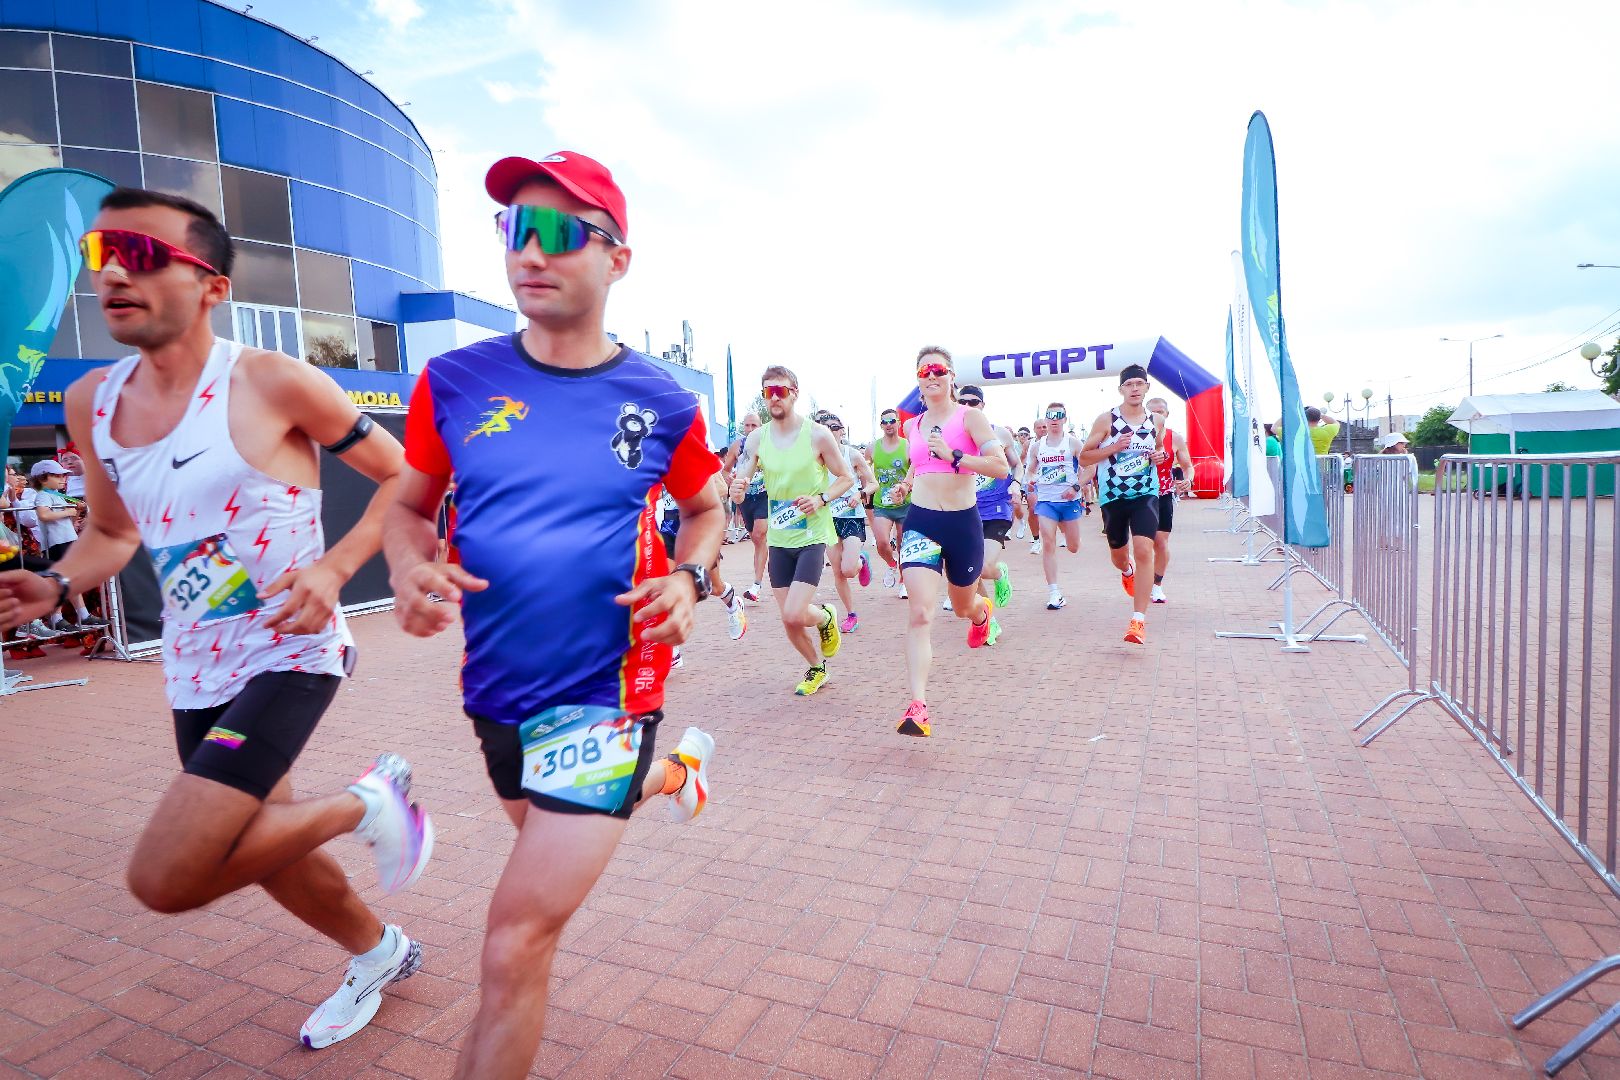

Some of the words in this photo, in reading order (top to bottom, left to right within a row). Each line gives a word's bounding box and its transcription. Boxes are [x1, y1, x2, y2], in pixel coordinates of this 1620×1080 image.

[981, 344, 1114, 379] СТАРТ
[904, 541, 929, 558] 332
[170, 566, 211, 611] 323
[542, 737, 602, 779] 308
